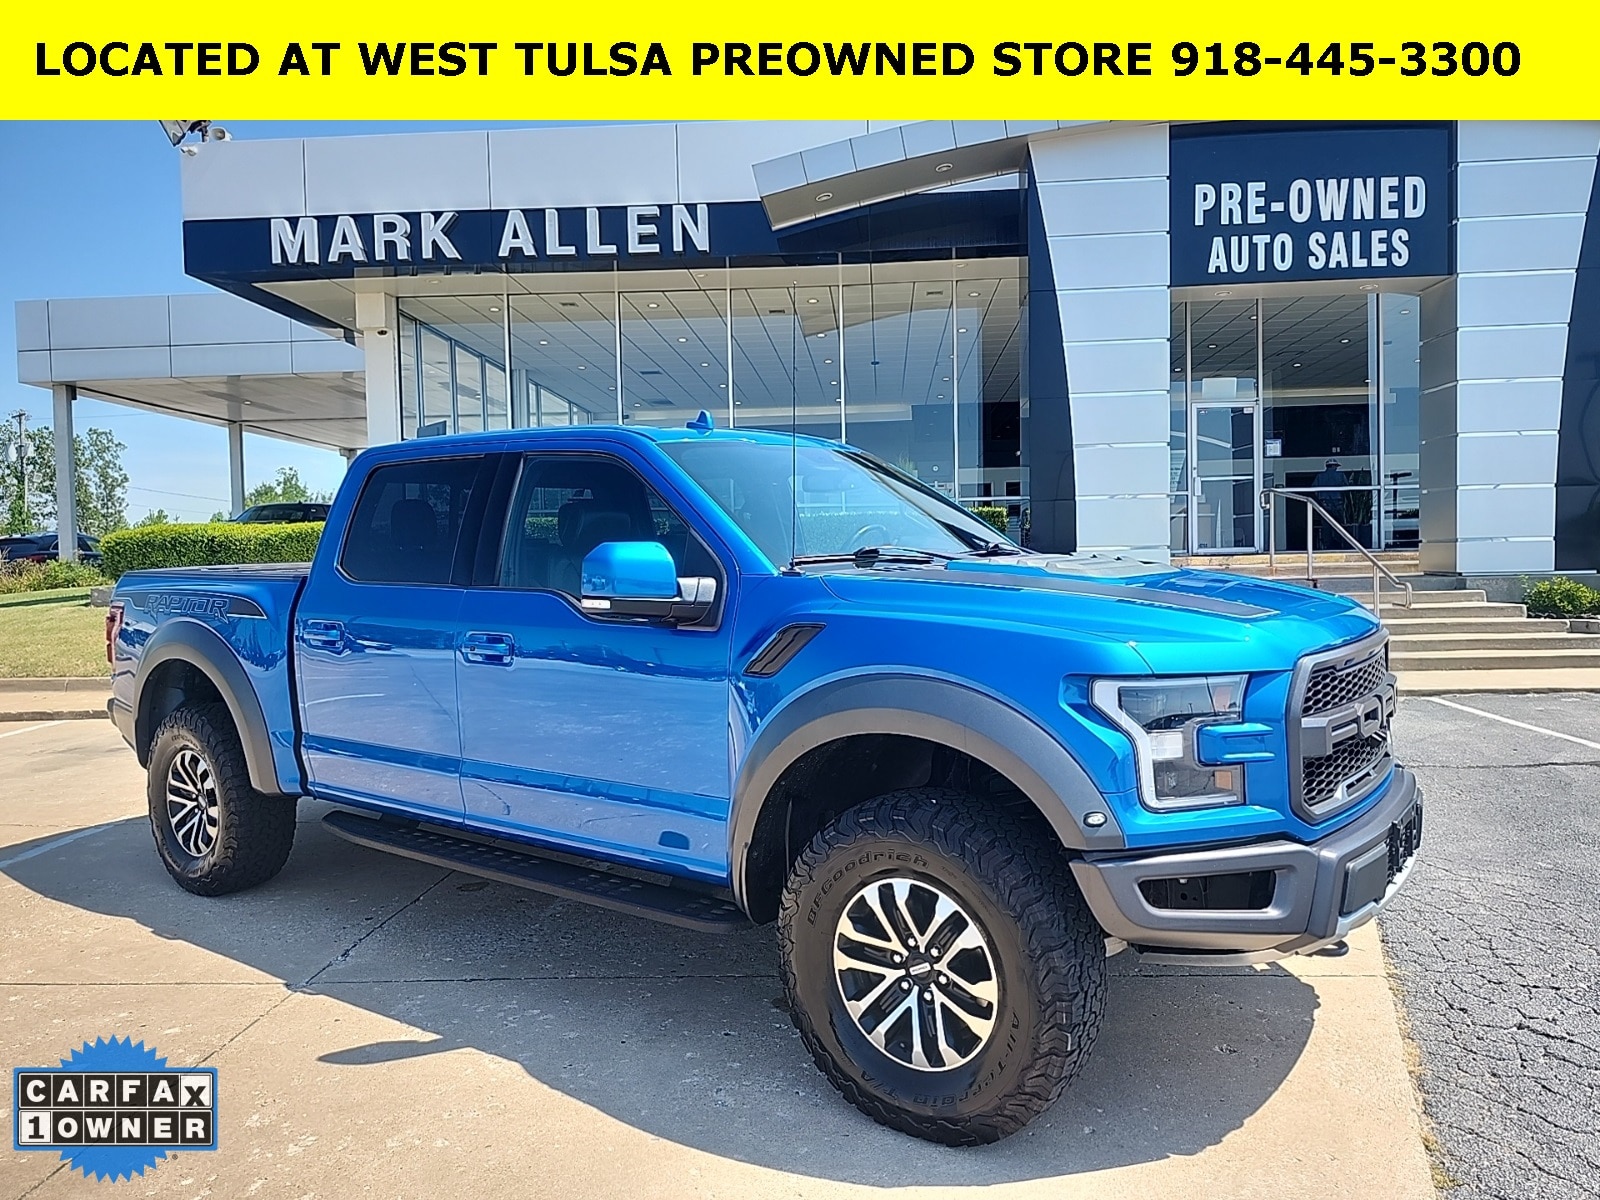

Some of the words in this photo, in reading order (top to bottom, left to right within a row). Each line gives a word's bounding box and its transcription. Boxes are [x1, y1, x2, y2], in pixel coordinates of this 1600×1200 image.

[1194, 176, 1427, 226] PRE-OWNED
[270, 212, 463, 266] MARK
[498, 203, 710, 258] ALLEN
[1207, 232, 1294, 274] AUTO
[1307, 228, 1410, 270] SALES
[143, 594, 230, 624] RAPTOR
[807, 849, 929, 928] BFGoodrich
